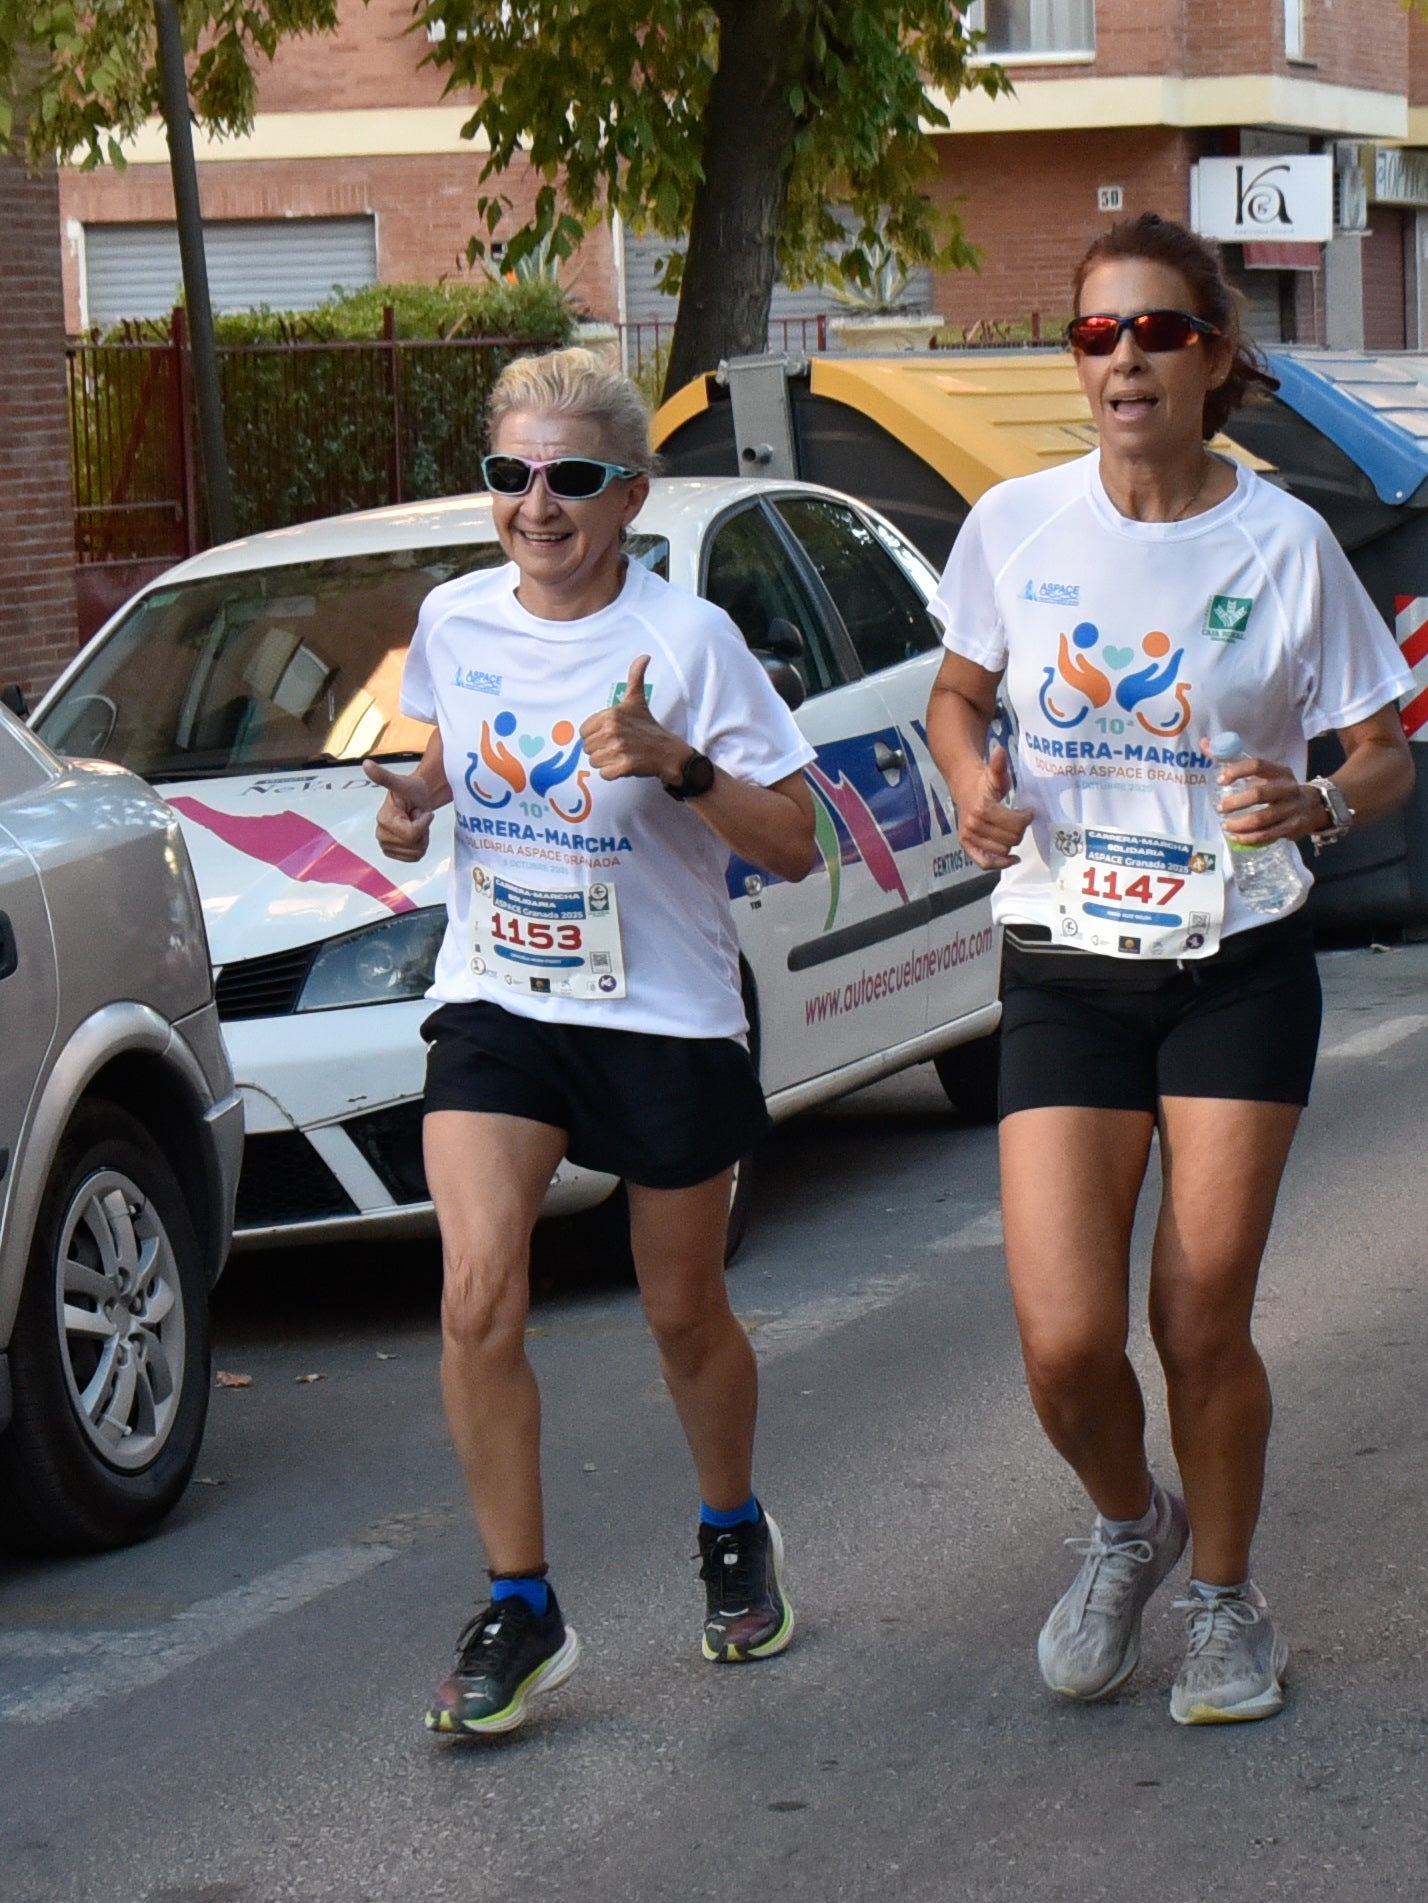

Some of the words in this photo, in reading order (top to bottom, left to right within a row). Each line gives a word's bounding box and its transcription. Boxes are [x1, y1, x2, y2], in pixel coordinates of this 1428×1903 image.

[1100, 189, 1119, 208] 50
[1040, 582, 1081, 596] ASPACE
[466, 669, 503, 686] ASPACE
[1025, 731, 1215, 769] CARRERA-MARCH
[1089, 765, 1143, 779] ASPACE
[1147, 768, 1207, 785] GRANADA
[457, 811, 633, 853] CARRERA-MARCHA
[517, 846, 562, 862] ASPACE
[564, 853, 621, 869] GRANADA
[1107, 843, 1165, 858] SOLIDARIA
[932, 852, 964, 877] CENTROS
[1088, 851, 1123, 864] ASPACE
[1125, 856, 1166, 869] Granada
[1167, 862, 1189, 874] 2025
[1082, 866, 1186, 906] 1147
[494, 899, 522, 913] ASPACE
[523, 907, 560, 919] Granada
[561, 911, 584, 919] 2025
[508, 893, 557, 909] SOLIDARIA
[491, 911, 582, 951] 1153
[805, 926, 992, 1026] www.autoescuelanevada.com
